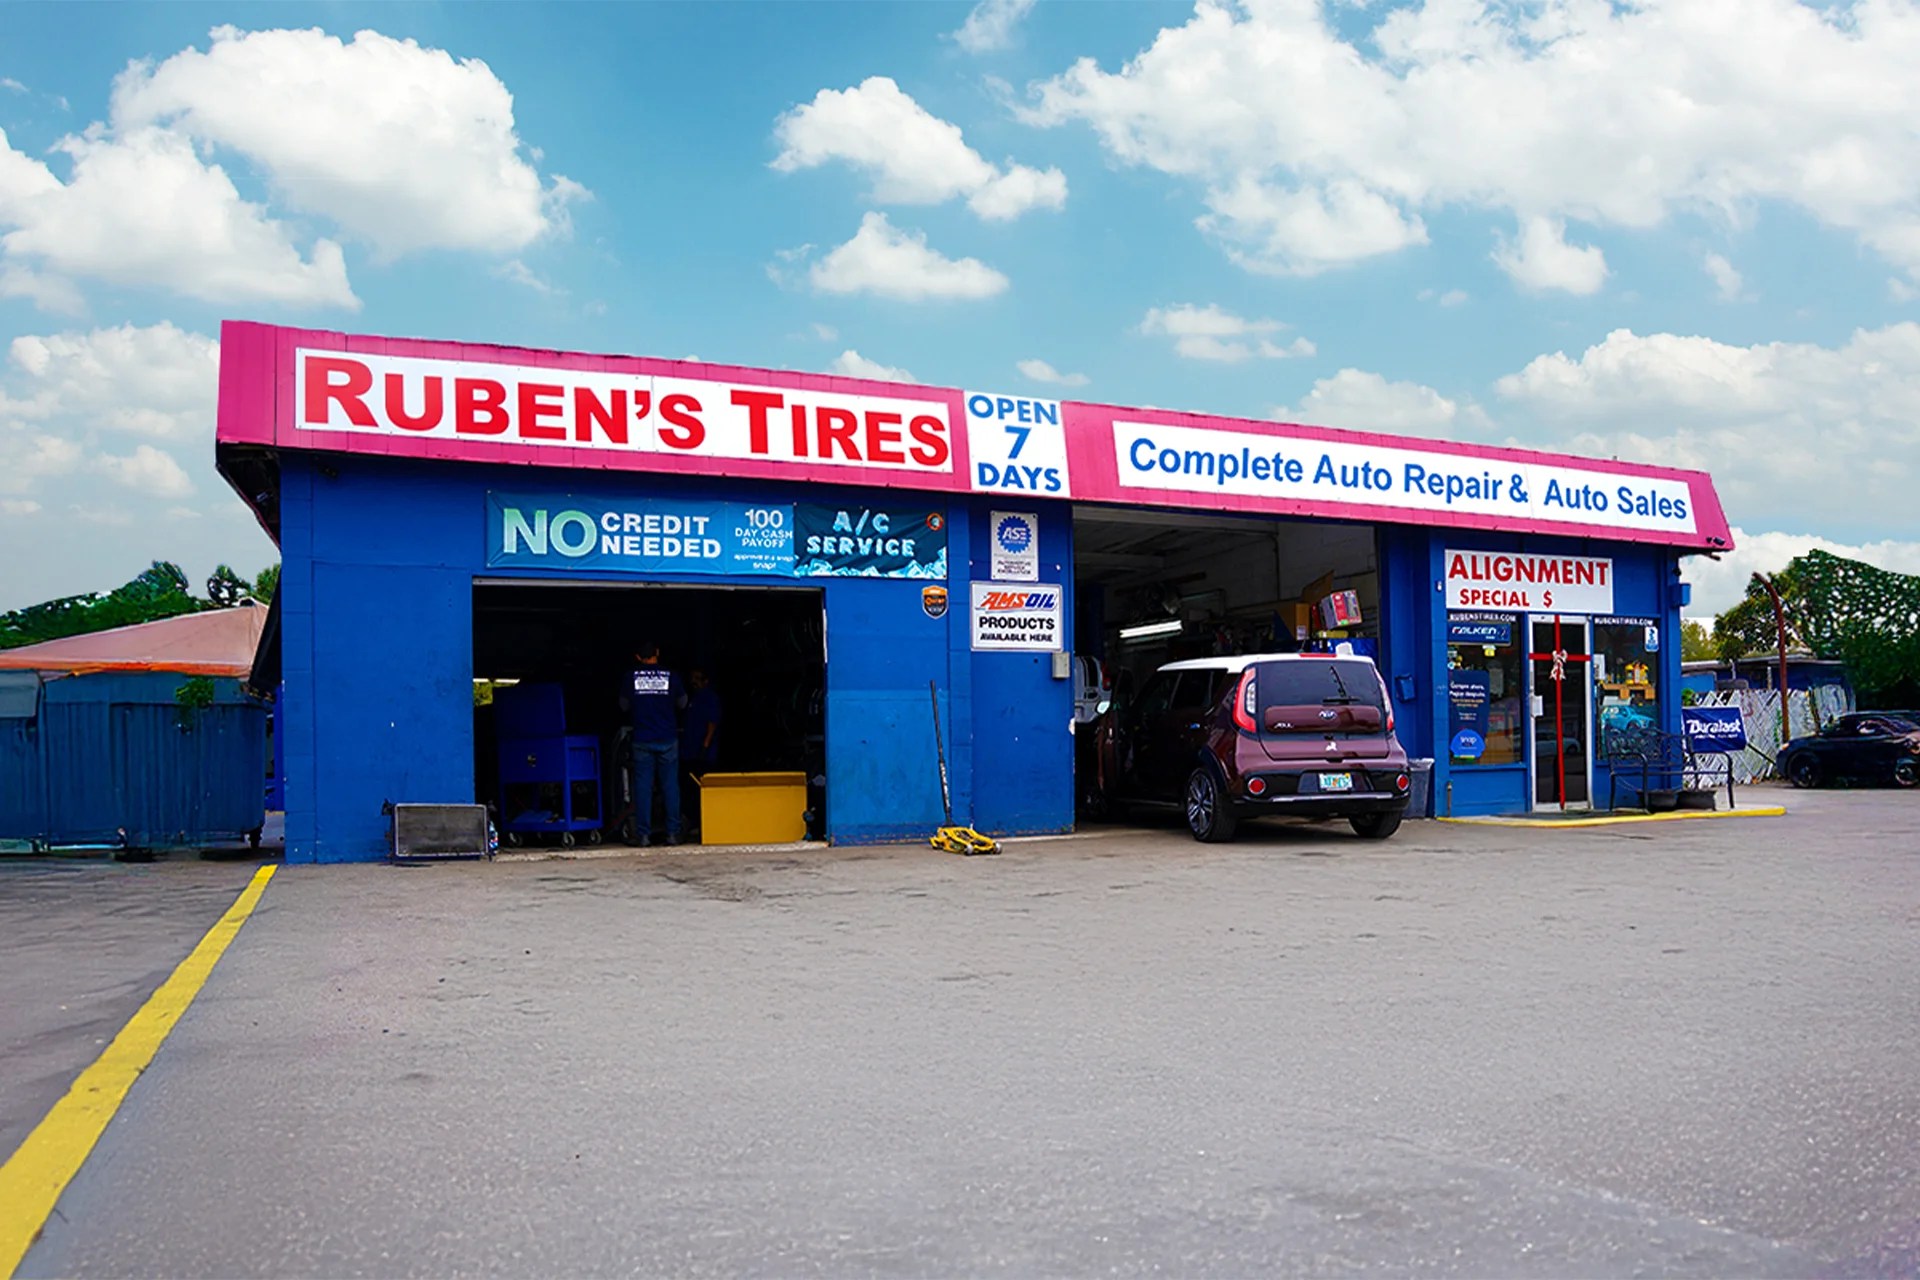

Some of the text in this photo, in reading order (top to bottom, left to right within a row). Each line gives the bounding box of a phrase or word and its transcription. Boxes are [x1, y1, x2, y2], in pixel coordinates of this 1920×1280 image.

[305, 355, 949, 468] RUBEN'S TIRES
[968, 393, 1058, 426] OPEN
[1004, 425, 1031, 459] 7
[977, 462, 1062, 492] DAYS
[1130, 437, 1687, 520] Complete Auto Repair & Auto Sales
[600, 512, 710, 536] CREDIT
[744, 508, 784, 529] 100
[833, 509, 890, 535] A/C
[503, 508, 598, 557] NO
[734, 527, 794, 540] DAY CASH
[741, 537, 786, 549] PAYOFF
[1002, 527, 1026, 540] ASE
[600, 534, 722, 559] NEEDED
[807, 535, 916, 558] SERVICE
[1448, 553, 1609, 587] ALIGNMENT
[980, 591, 1055, 611] AMSOIL
[1459, 588, 1553, 608] SPECIAL $
[978, 615, 1055, 631] PRODUCTS
[1451, 626, 1497, 635] FALKEN
[979, 632, 1053, 642] AVAILABLE HERE
[1686, 718, 1741, 734] Duralast
